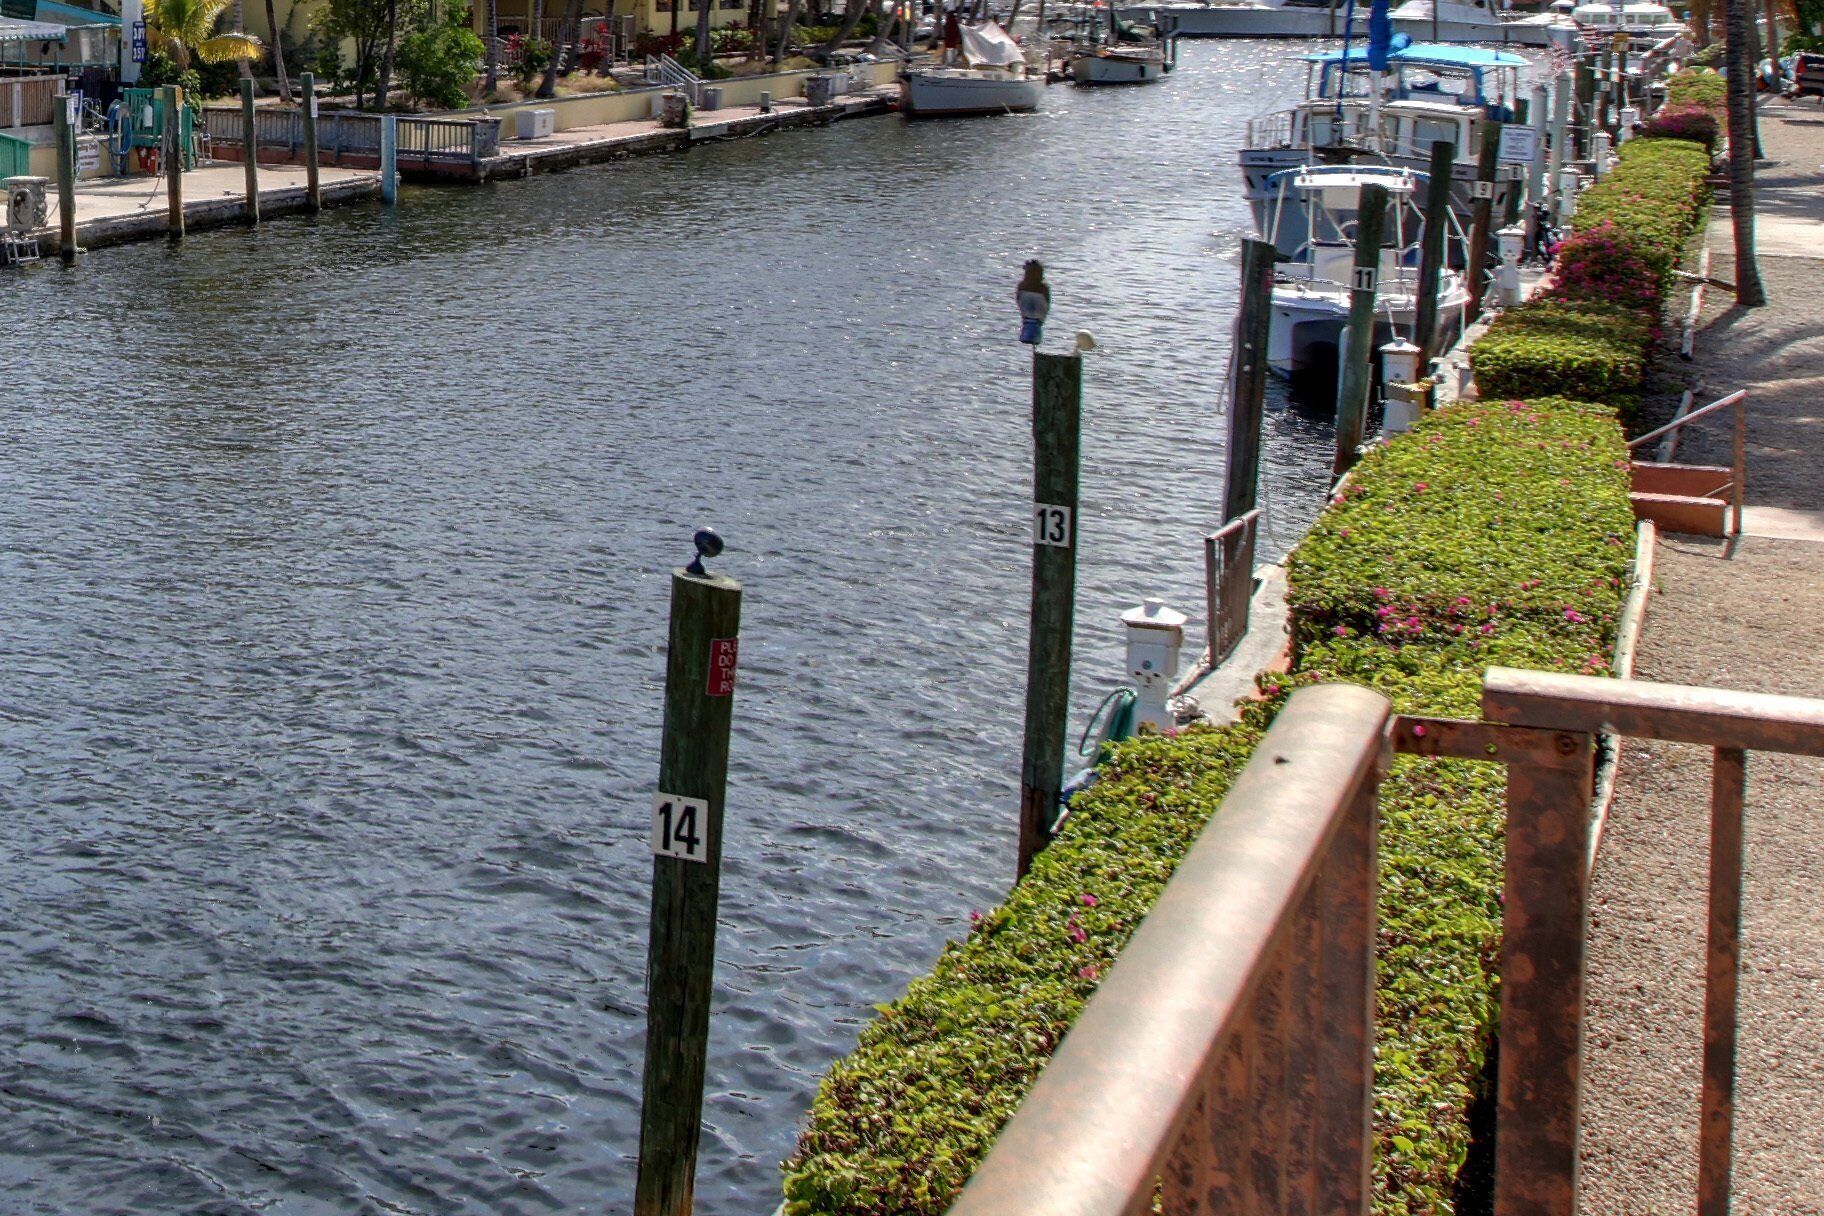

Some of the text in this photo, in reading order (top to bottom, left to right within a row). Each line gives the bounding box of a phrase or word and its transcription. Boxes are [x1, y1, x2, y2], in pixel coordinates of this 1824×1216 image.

[1356, 269, 1373, 289] 11
[1038, 508, 1065, 542] 13
[659, 801, 700, 855] 14
